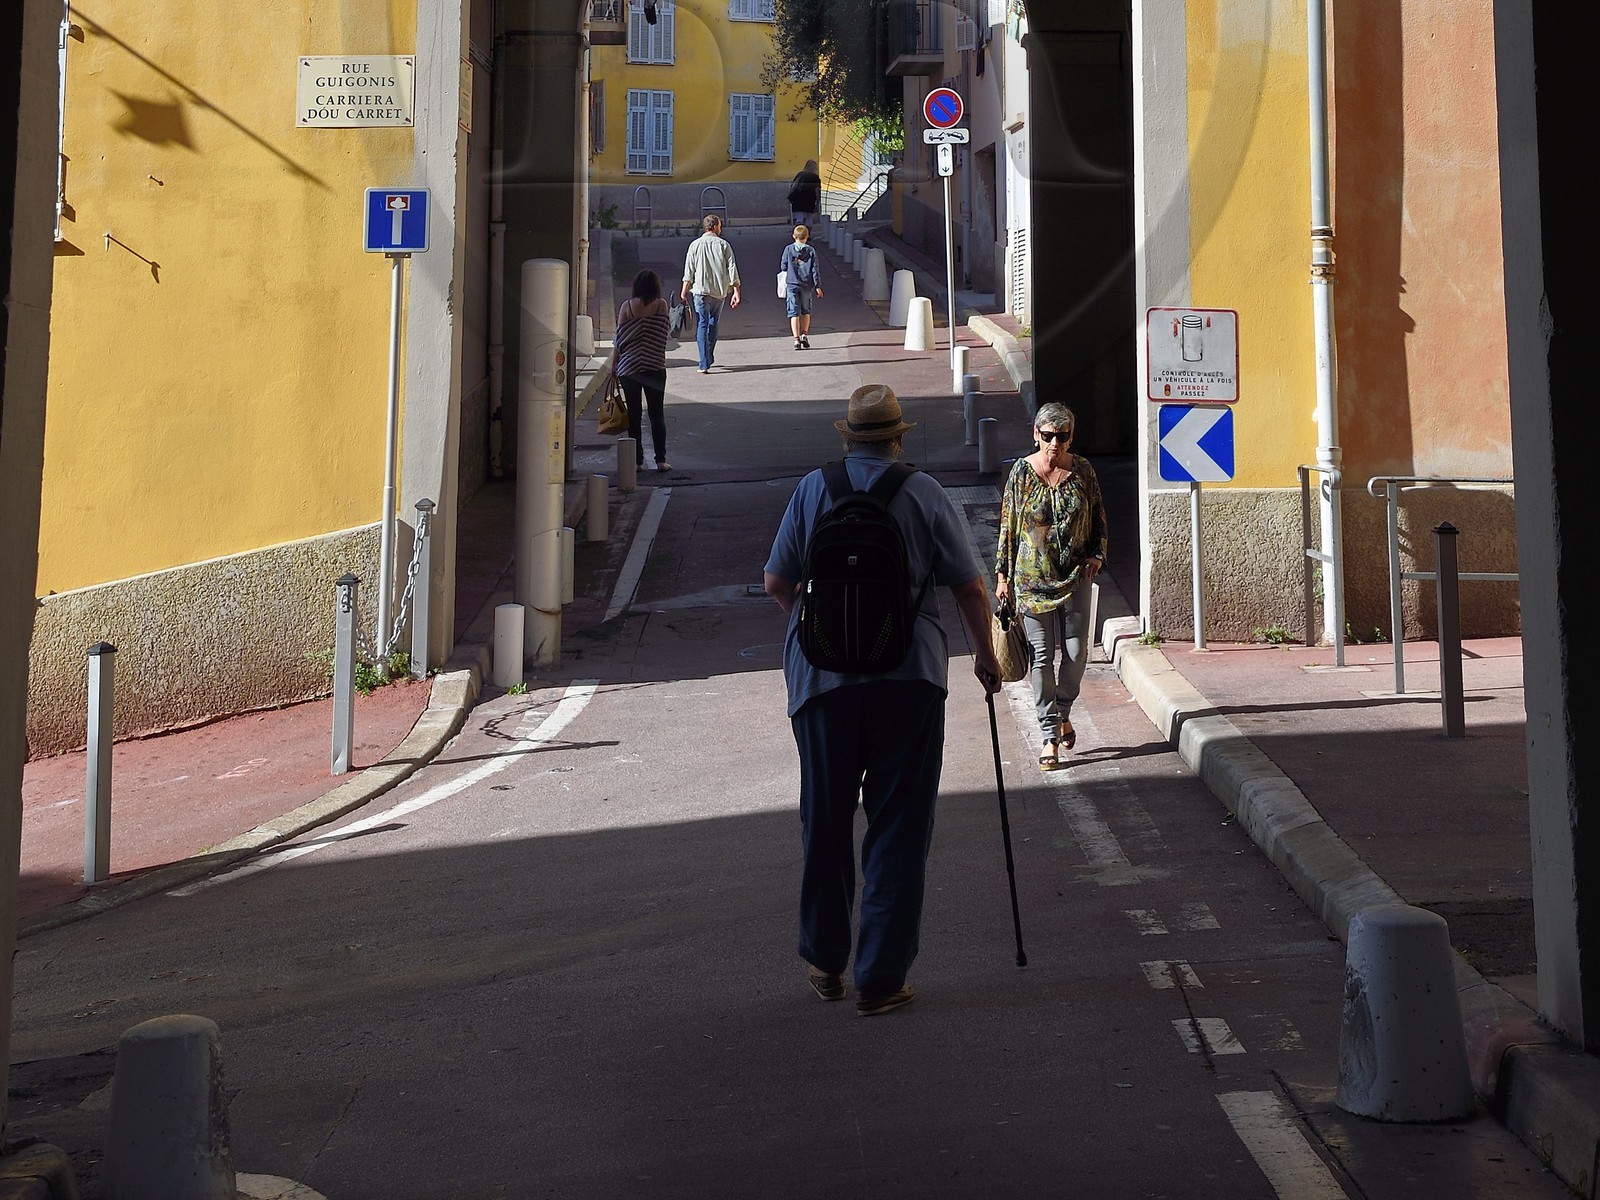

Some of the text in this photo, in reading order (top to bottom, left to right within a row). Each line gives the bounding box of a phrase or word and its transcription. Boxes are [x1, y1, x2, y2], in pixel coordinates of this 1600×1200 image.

[342, 63, 370, 73] RUE
[316, 77, 395, 87] GUIGONIS
[316, 95, 394, 105] CARRIERA
[346, 109, 402, 118] CARRET
